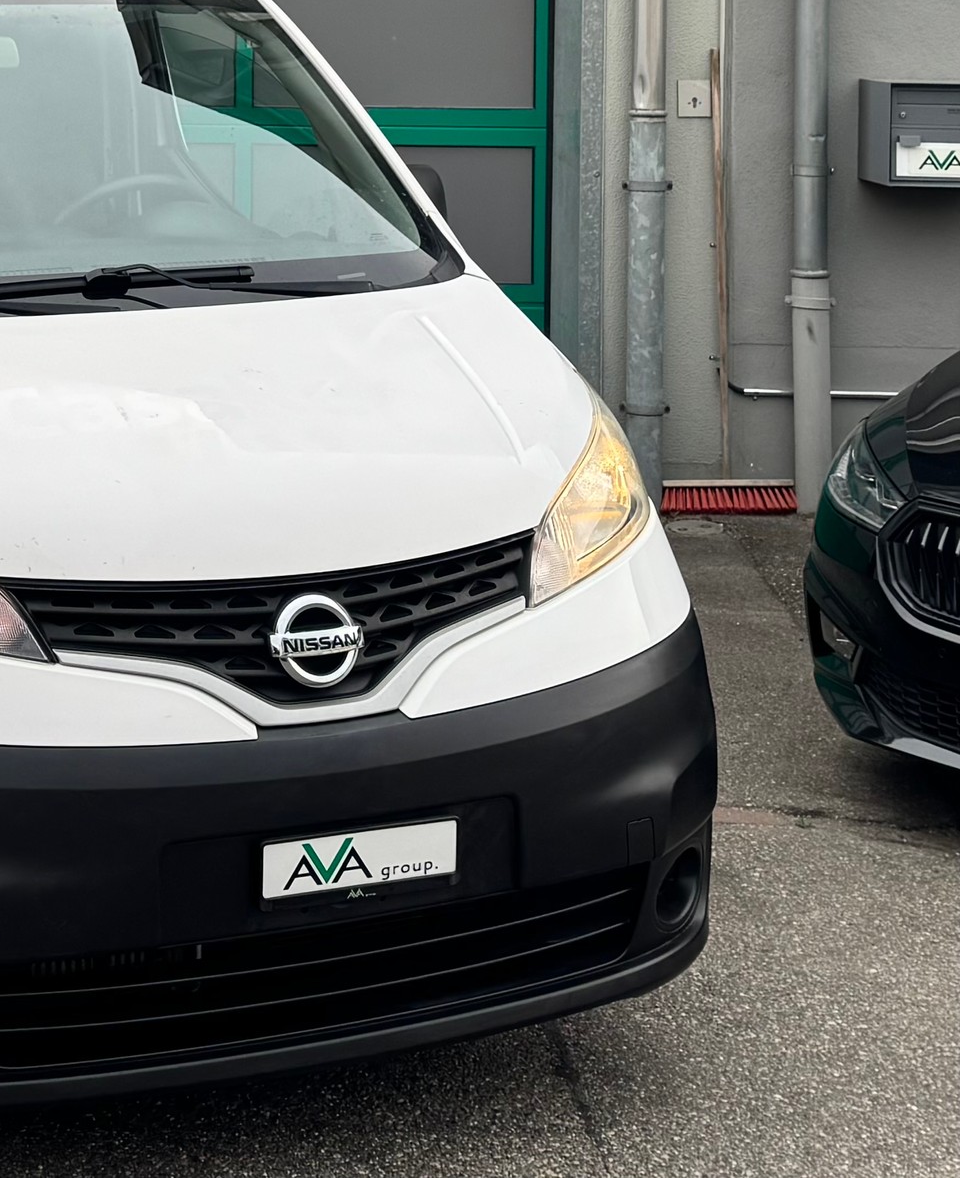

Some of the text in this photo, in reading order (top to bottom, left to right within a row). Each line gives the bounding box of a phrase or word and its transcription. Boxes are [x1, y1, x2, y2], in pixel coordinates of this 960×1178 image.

[918, 149, 960, 171] AVA
[282, 631, 357, 654] NISSAN
[282, 836, 439, 891] AVA group.
